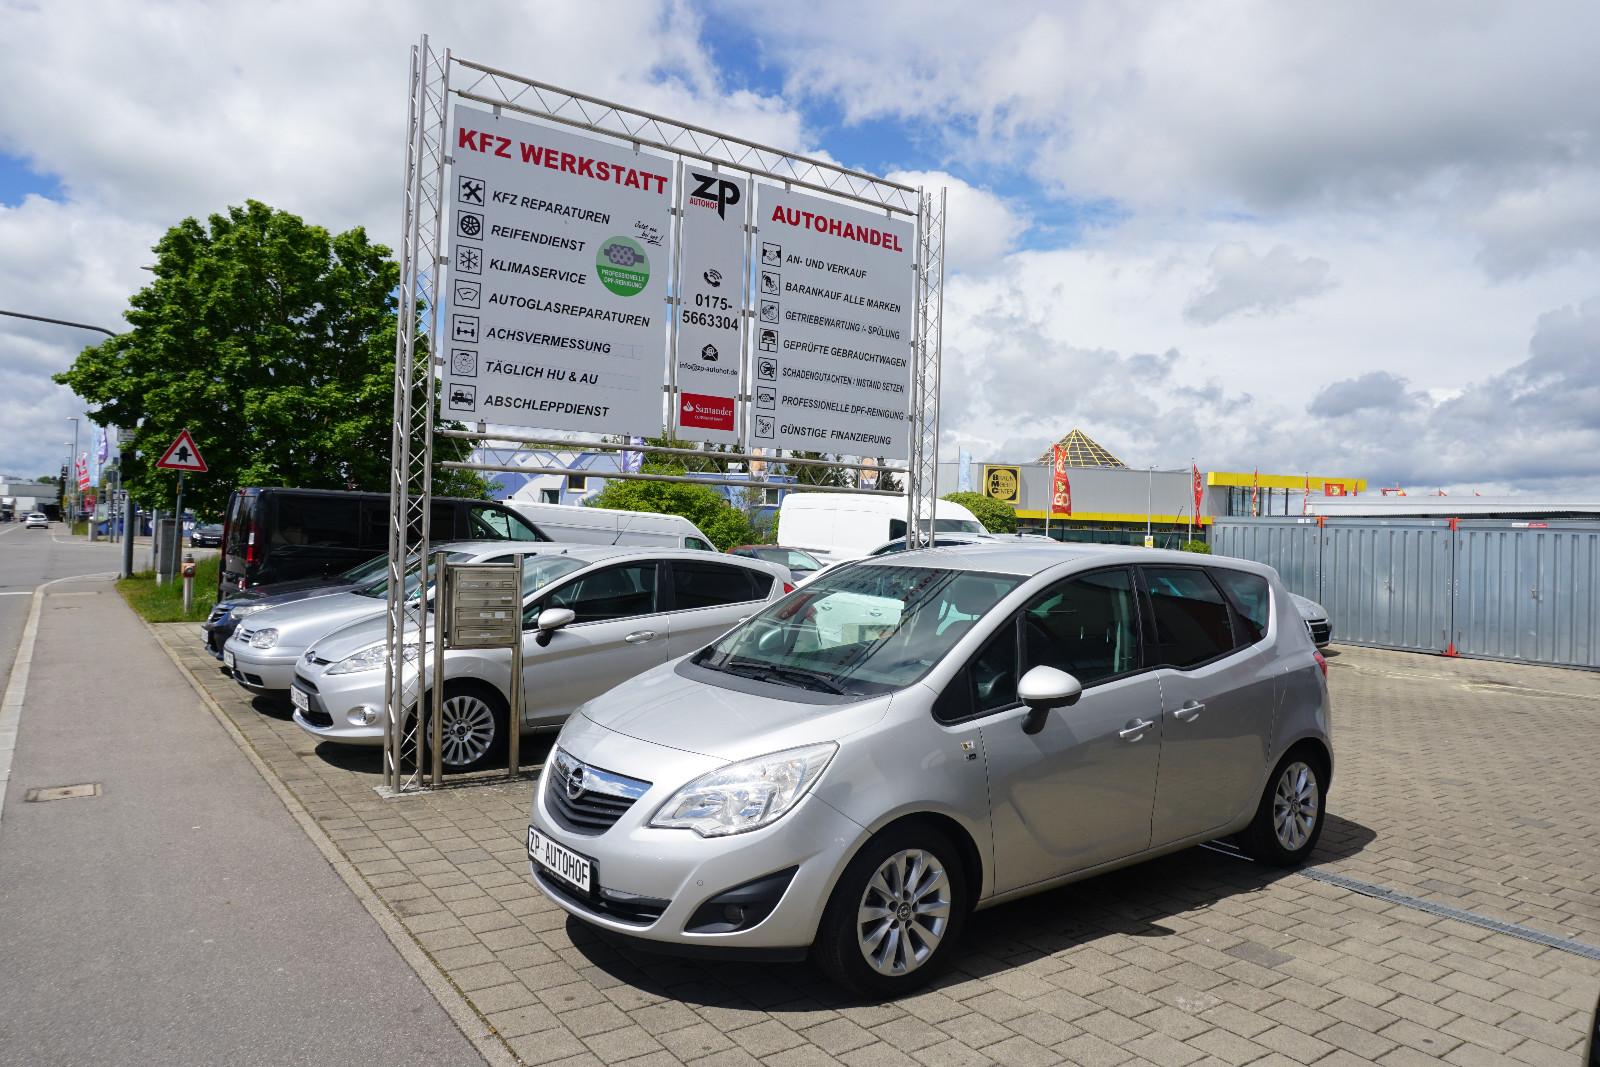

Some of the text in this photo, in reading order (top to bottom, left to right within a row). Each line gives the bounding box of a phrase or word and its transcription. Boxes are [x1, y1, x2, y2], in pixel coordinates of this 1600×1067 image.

[458, 127, 668, 194] KFZ WERKSTATT
[493, 190, 611, 225] KFZ REPARATUREN
[689, 197, 718, 210] AUTOHOF
[491, 225, 586, 252] REIFENDIENST
[772, 205, 903, 252] AUTOHANDEL
[489, 258, 587, 285] KLIMASERVICE
[786, 254, 867, 279] AN- UND VERKAUF
[488, 293, 650, 328] AUTOGLASREPARATUREN
[695, 294, 733, 311] 0175-
[785, 282, 901, 313] BARANKAUF ALLE MARKEN
[682, 310, 739, 331] 5663304
[785, 310, 861, 332] GETRIEBEWARTUNG
[867, 325, 900, 340] SPÜLUNG
[486, 327, 611, 353] ACHSVERMESSUNG
[783, 339, 907, 367] GEPRÜFTE GEBRAUCHTWAGEN
[485, 360, 599, 385] TÄGLICH HU & AU
[782, 367, 852, 385] SCHADENGUTACHTEN
[882, 382, 905, 393] SETZEN
[484, 394, 610, 417] ABSCHLEPPDIENST
[695, 403, 733, 416] Santander
[781, 395, 904, 420] PROFESSIONELLE DPF-REINIGUNG
[780, 424, 892, 445] GÜNSTIGE FINANZIERUNG
[545, 841, 589, 885] AUTOHOF
